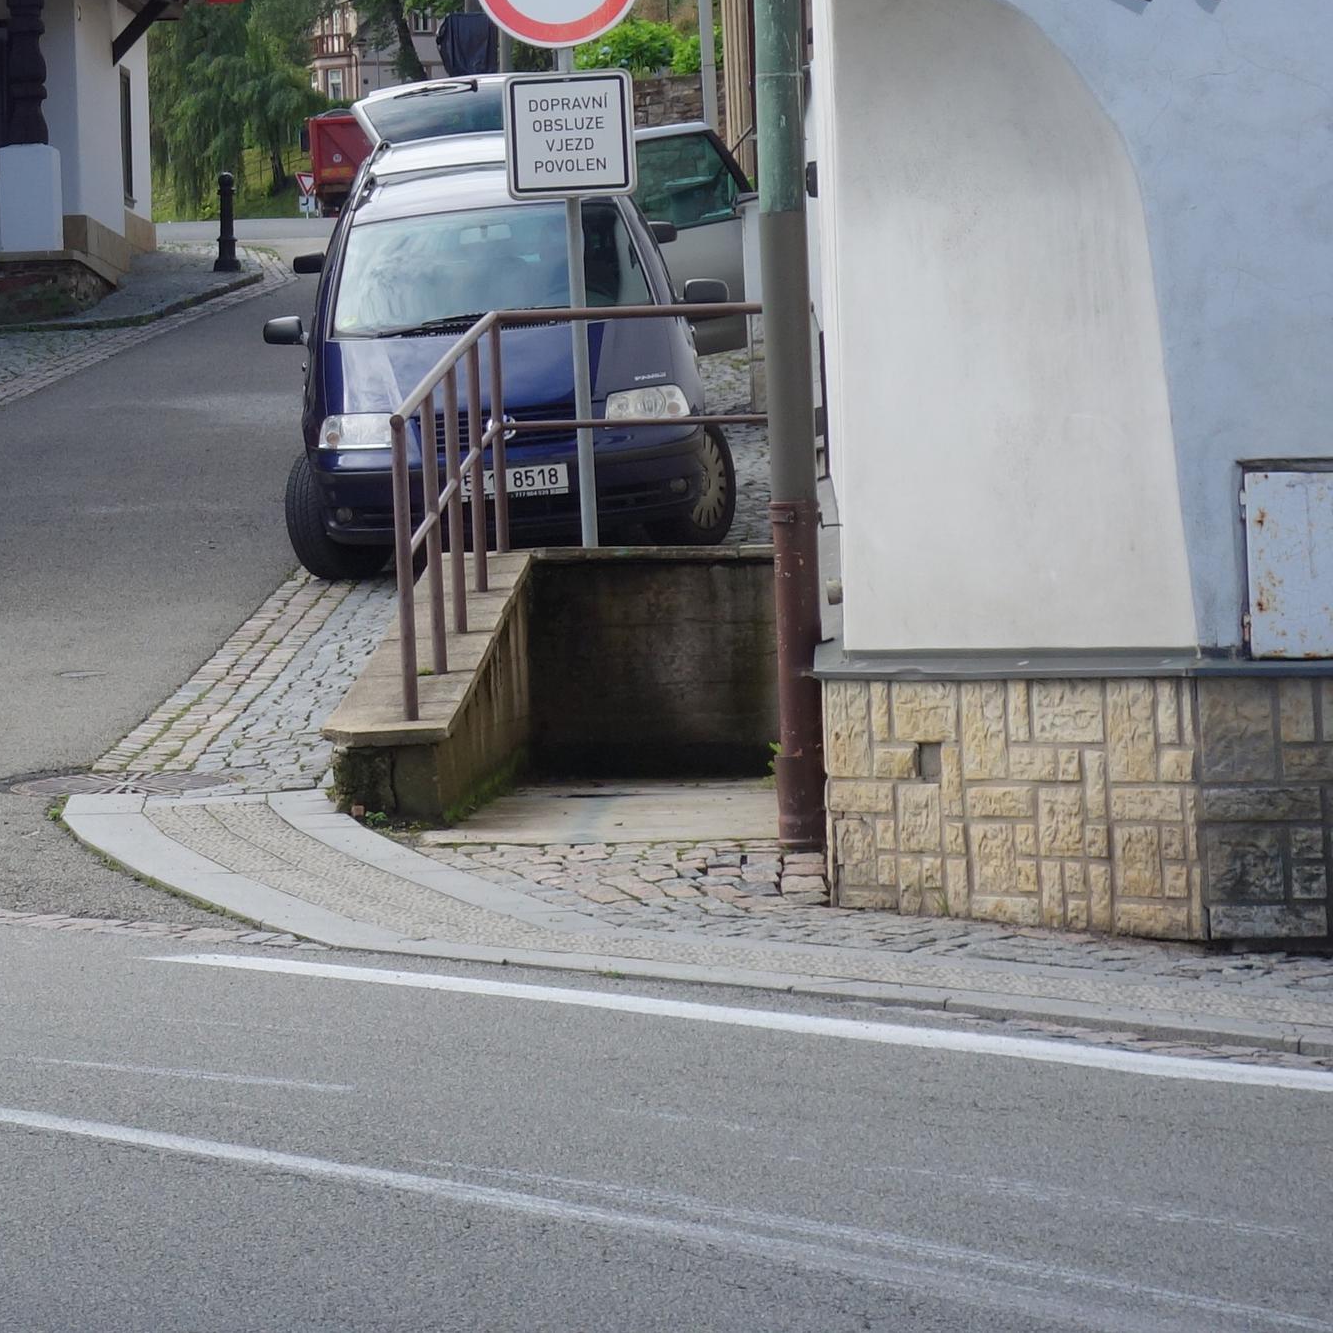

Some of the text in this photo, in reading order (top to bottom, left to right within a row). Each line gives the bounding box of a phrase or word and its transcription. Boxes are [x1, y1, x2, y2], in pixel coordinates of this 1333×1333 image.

[528, 92, 608, 112] DOPRAVNÍ
[533, 116, 604, 132] OBSLUZE
[546, 137, 594, 152] VJEZD
[535, 157, 607, 173] POVOLEN
[513, 467, 559, 488] 8518
